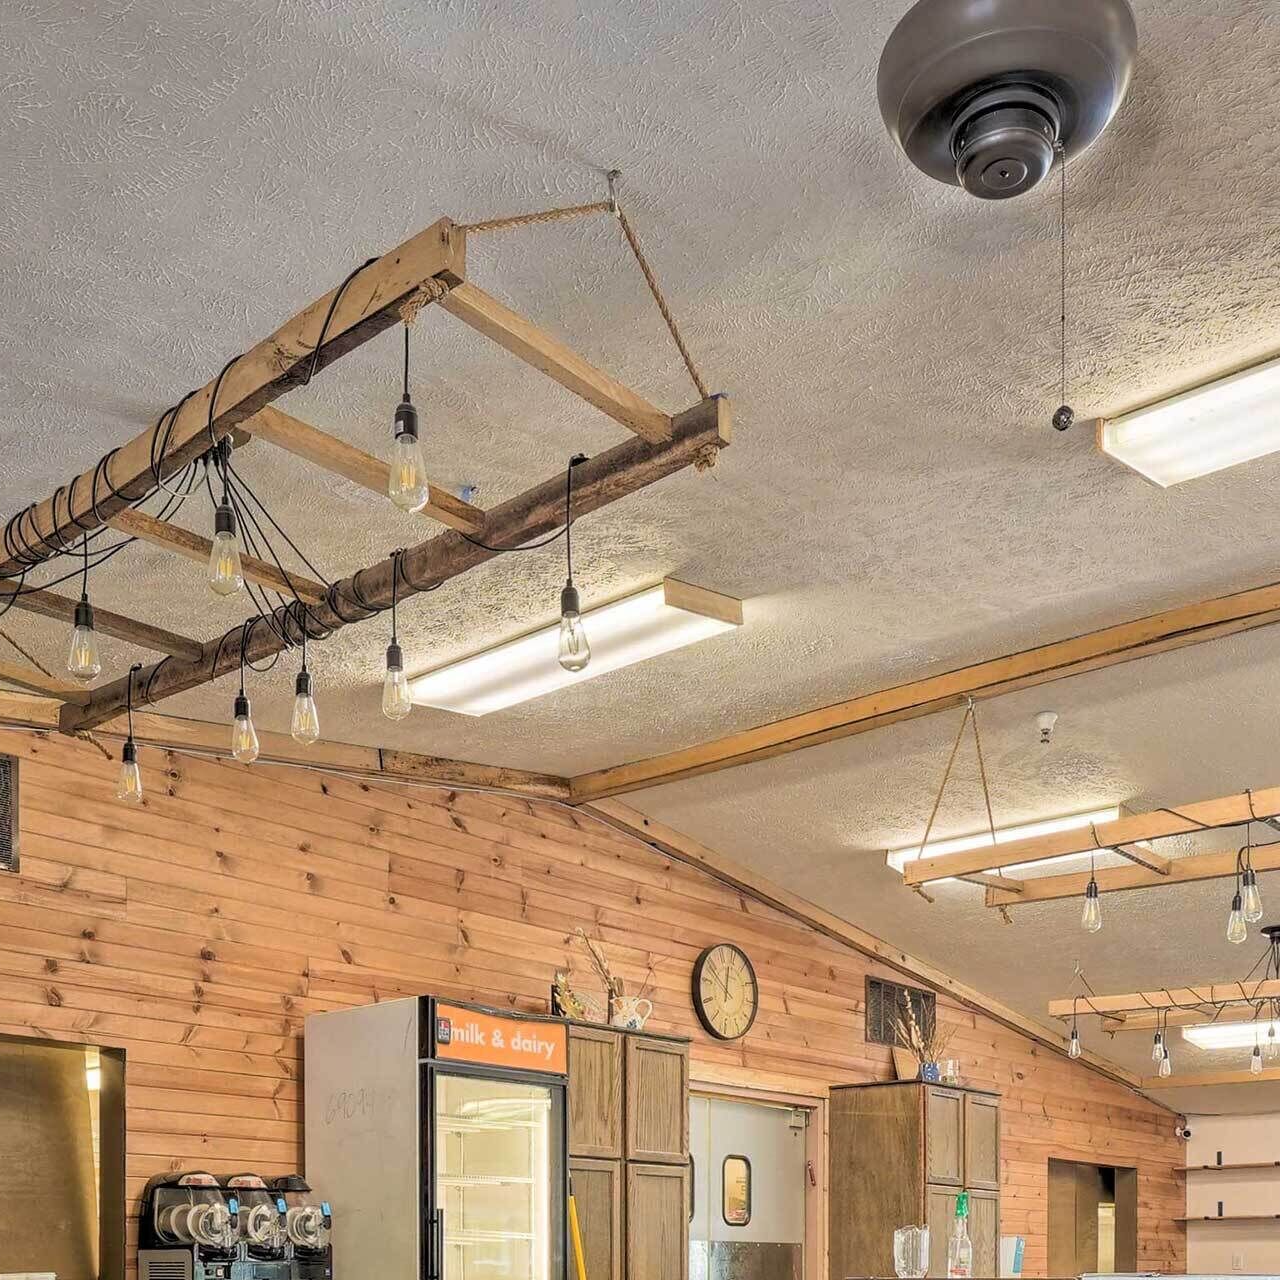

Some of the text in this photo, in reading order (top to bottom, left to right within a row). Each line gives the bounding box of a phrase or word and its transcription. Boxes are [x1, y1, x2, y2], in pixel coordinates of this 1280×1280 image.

[451, 1023, 486, 1047] milk
[492, 1028, 505, 1049] &
[511, 1032, 556, 1060] dairy
